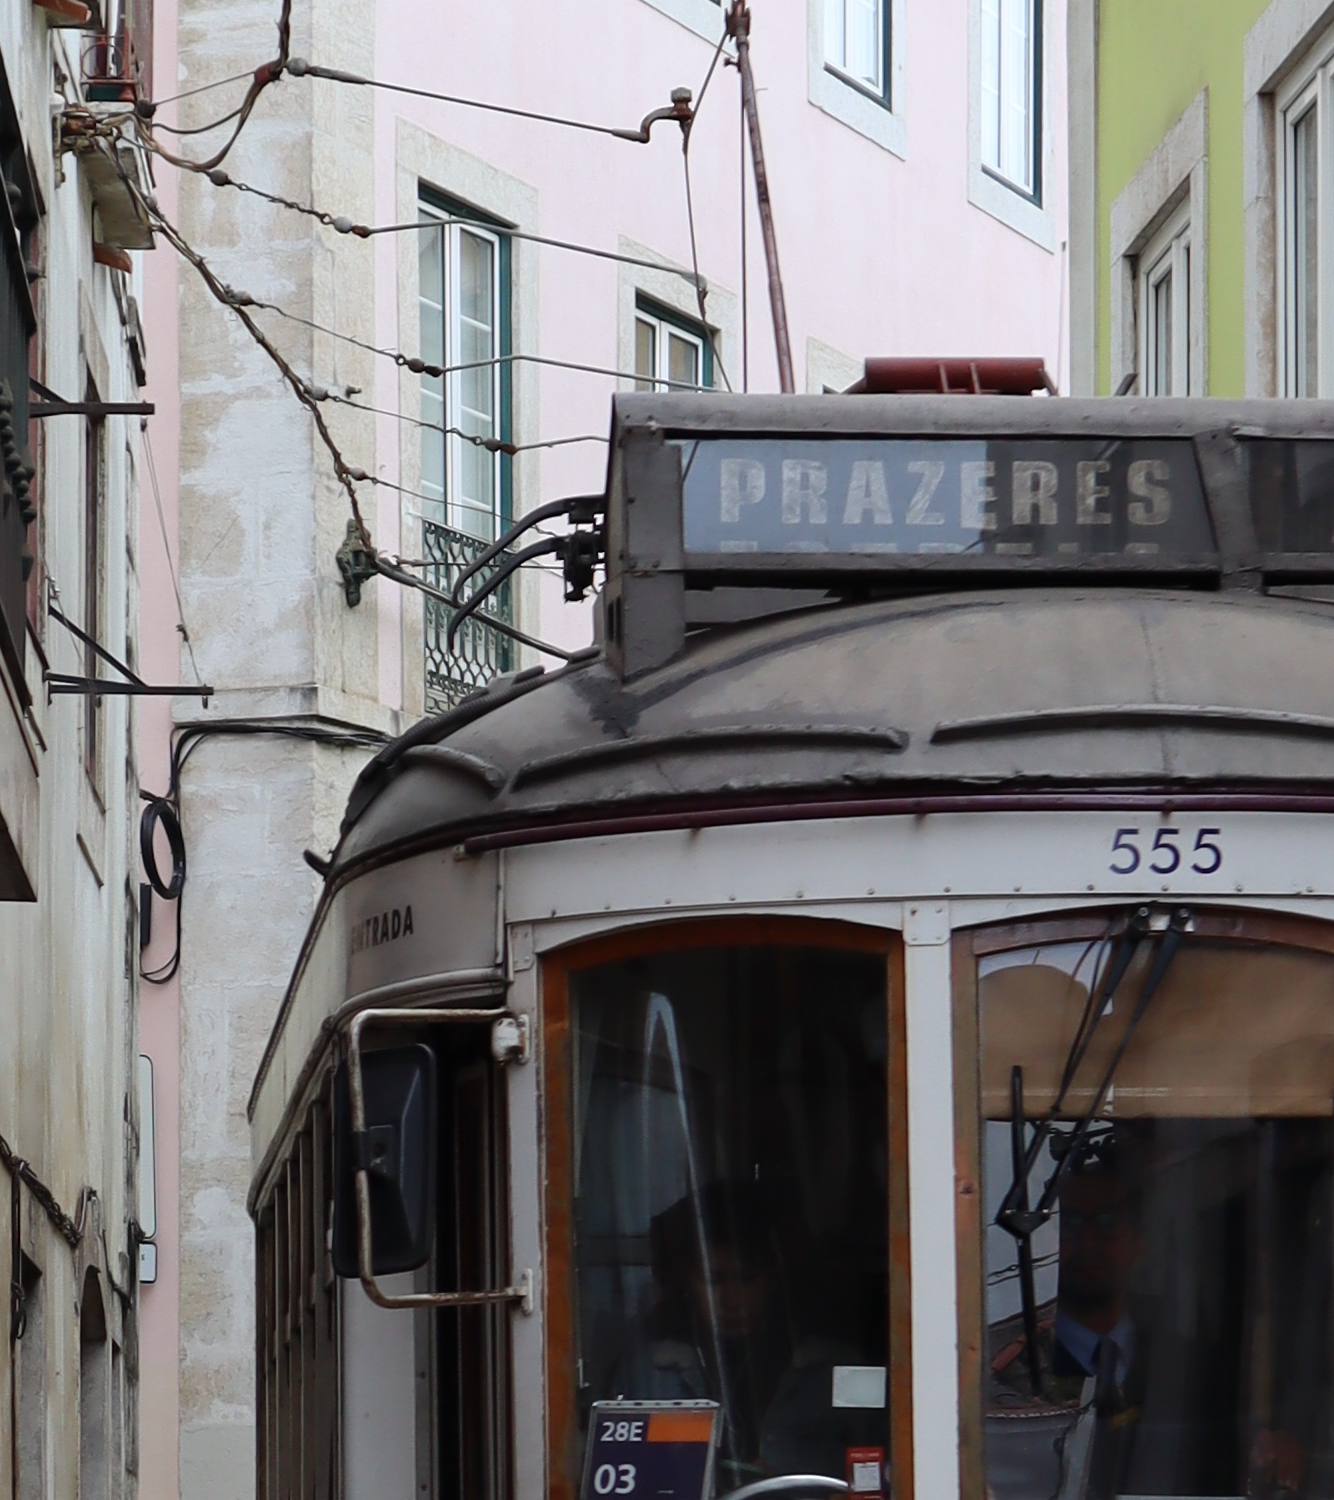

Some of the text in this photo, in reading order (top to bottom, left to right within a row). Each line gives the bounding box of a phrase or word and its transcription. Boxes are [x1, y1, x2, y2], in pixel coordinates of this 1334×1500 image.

[719, 457, 1171, 530] PRAZERES
[1109, 827, 1223, 875] 555
[600, 1421, 644, 1442] 28E
[593, 1463, 637, 1495] 03
